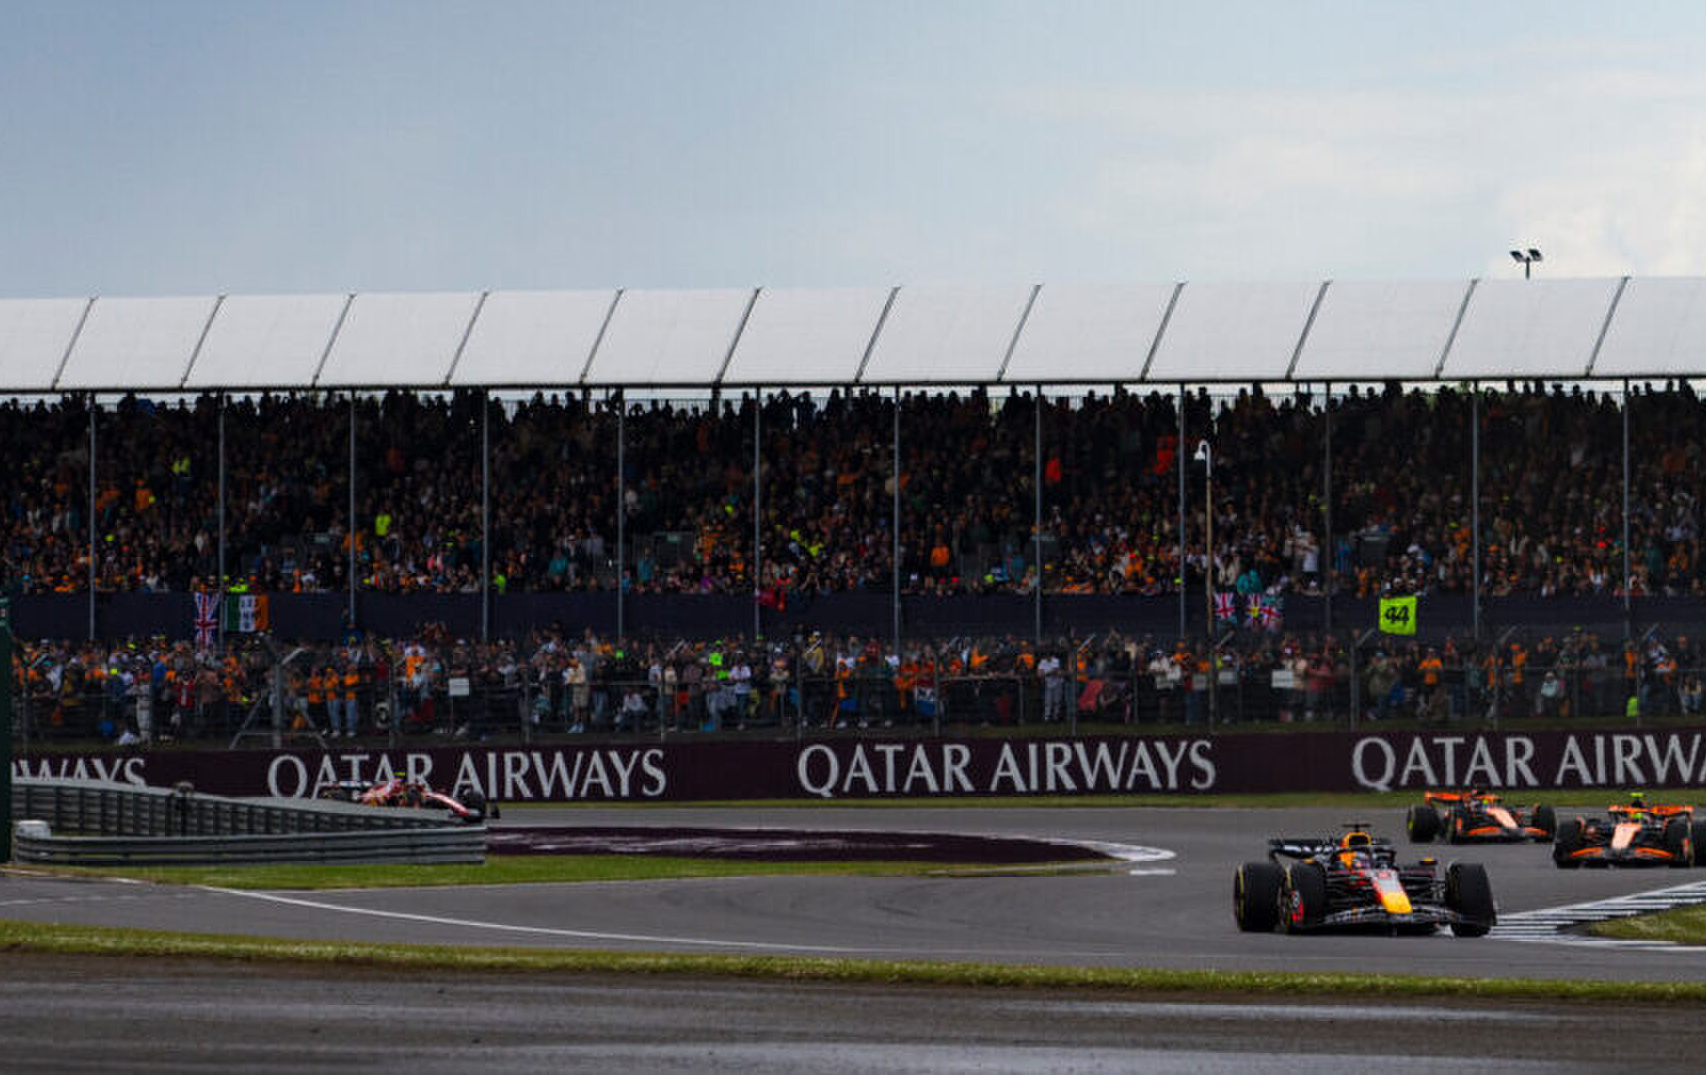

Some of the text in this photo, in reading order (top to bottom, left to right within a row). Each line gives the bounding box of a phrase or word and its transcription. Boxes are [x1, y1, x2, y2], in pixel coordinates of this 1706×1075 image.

[1385, 606, 1410, 624] 44
[453, 748, 667, 799] AIRWAYS
[797, 739, 1216, 798] QATAR AIRWAYS
[1352, 736, 1540, 792] QATAR
